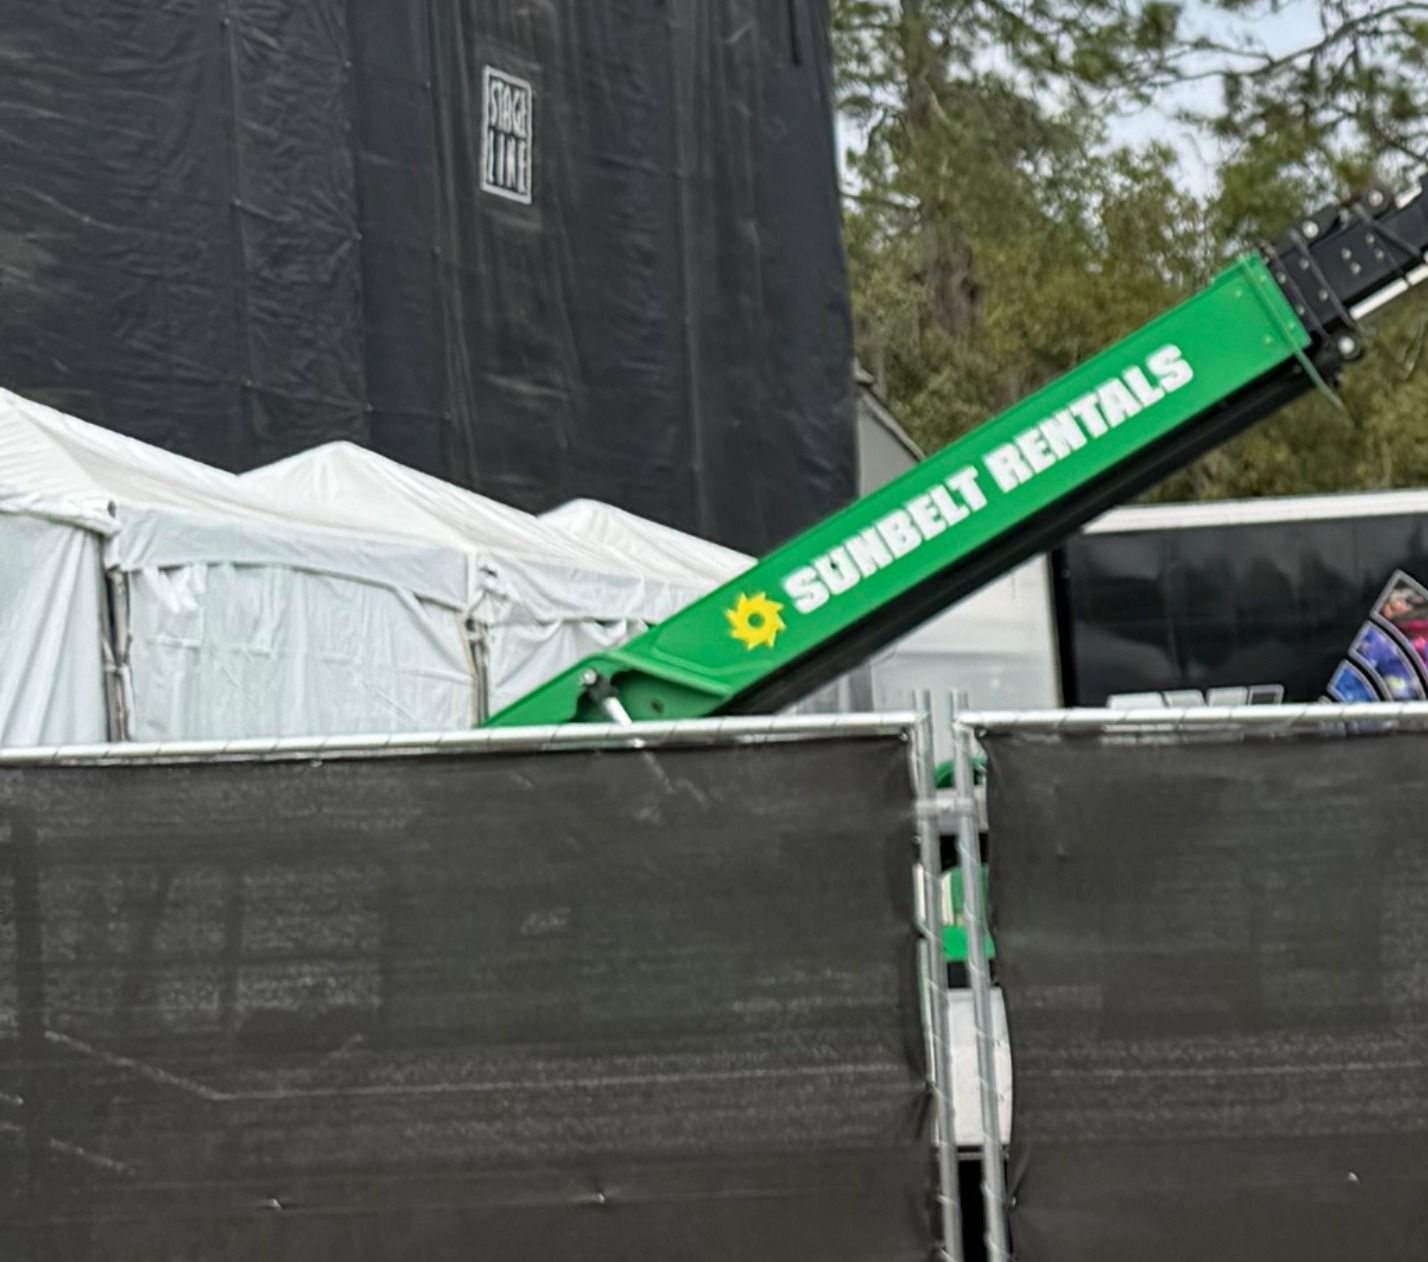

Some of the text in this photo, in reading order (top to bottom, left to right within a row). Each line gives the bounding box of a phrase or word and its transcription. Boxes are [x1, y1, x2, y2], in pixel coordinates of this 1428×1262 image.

[487, 128, 527, 194] LINE
[782, 343, 1194, 615] SUNBELT RENTALS
